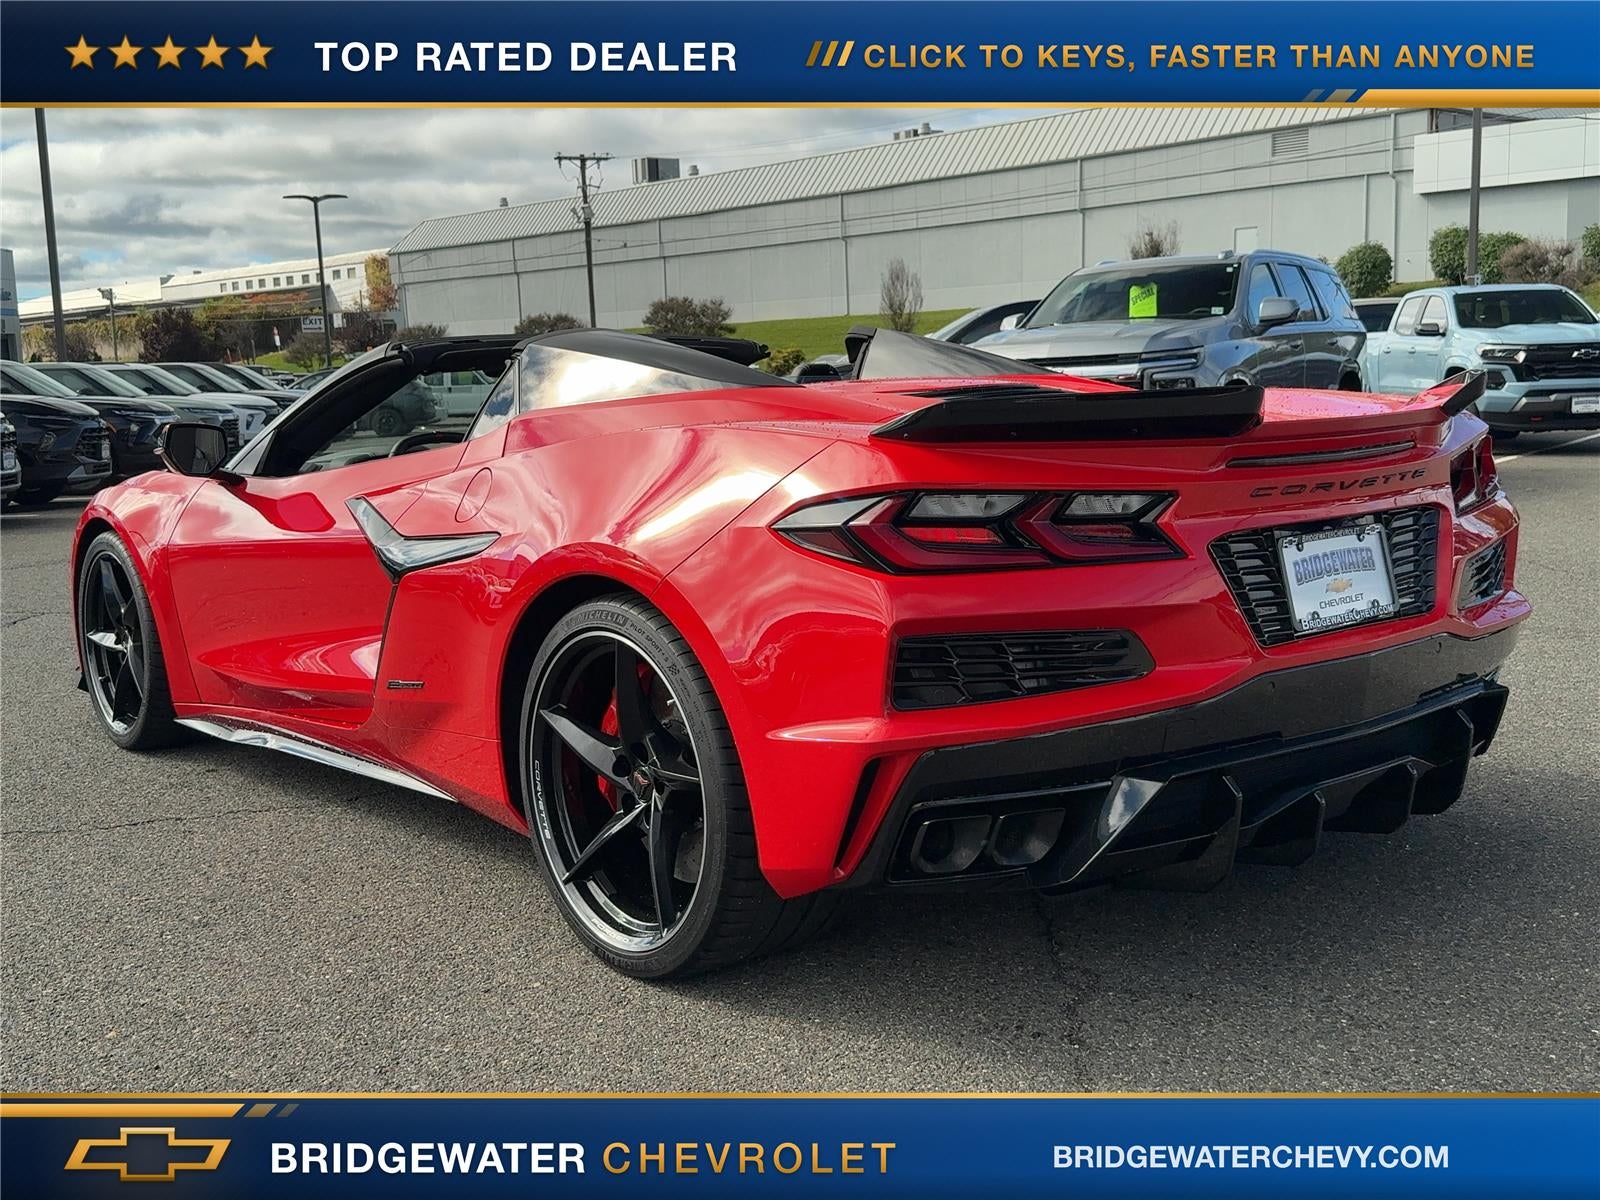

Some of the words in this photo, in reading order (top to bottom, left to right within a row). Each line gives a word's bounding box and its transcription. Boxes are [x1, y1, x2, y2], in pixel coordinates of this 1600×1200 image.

[1131, 287, 1155, 305] SPECIAL
[302, 317, 323, 326] EXIT
[1249, 467, 1426, 498] CORVETTE
[1293, 546, 1376, 586] BRIDGEWATER
[1319, 592, 1364, 609] CHEVROLET
[577, 610, 626, 625] MICHELIN
[630, 622, 646, 636] PILOT
[645, 634, 662, 653] SPORT
[534, 759, 551, 840] CORVETTE
